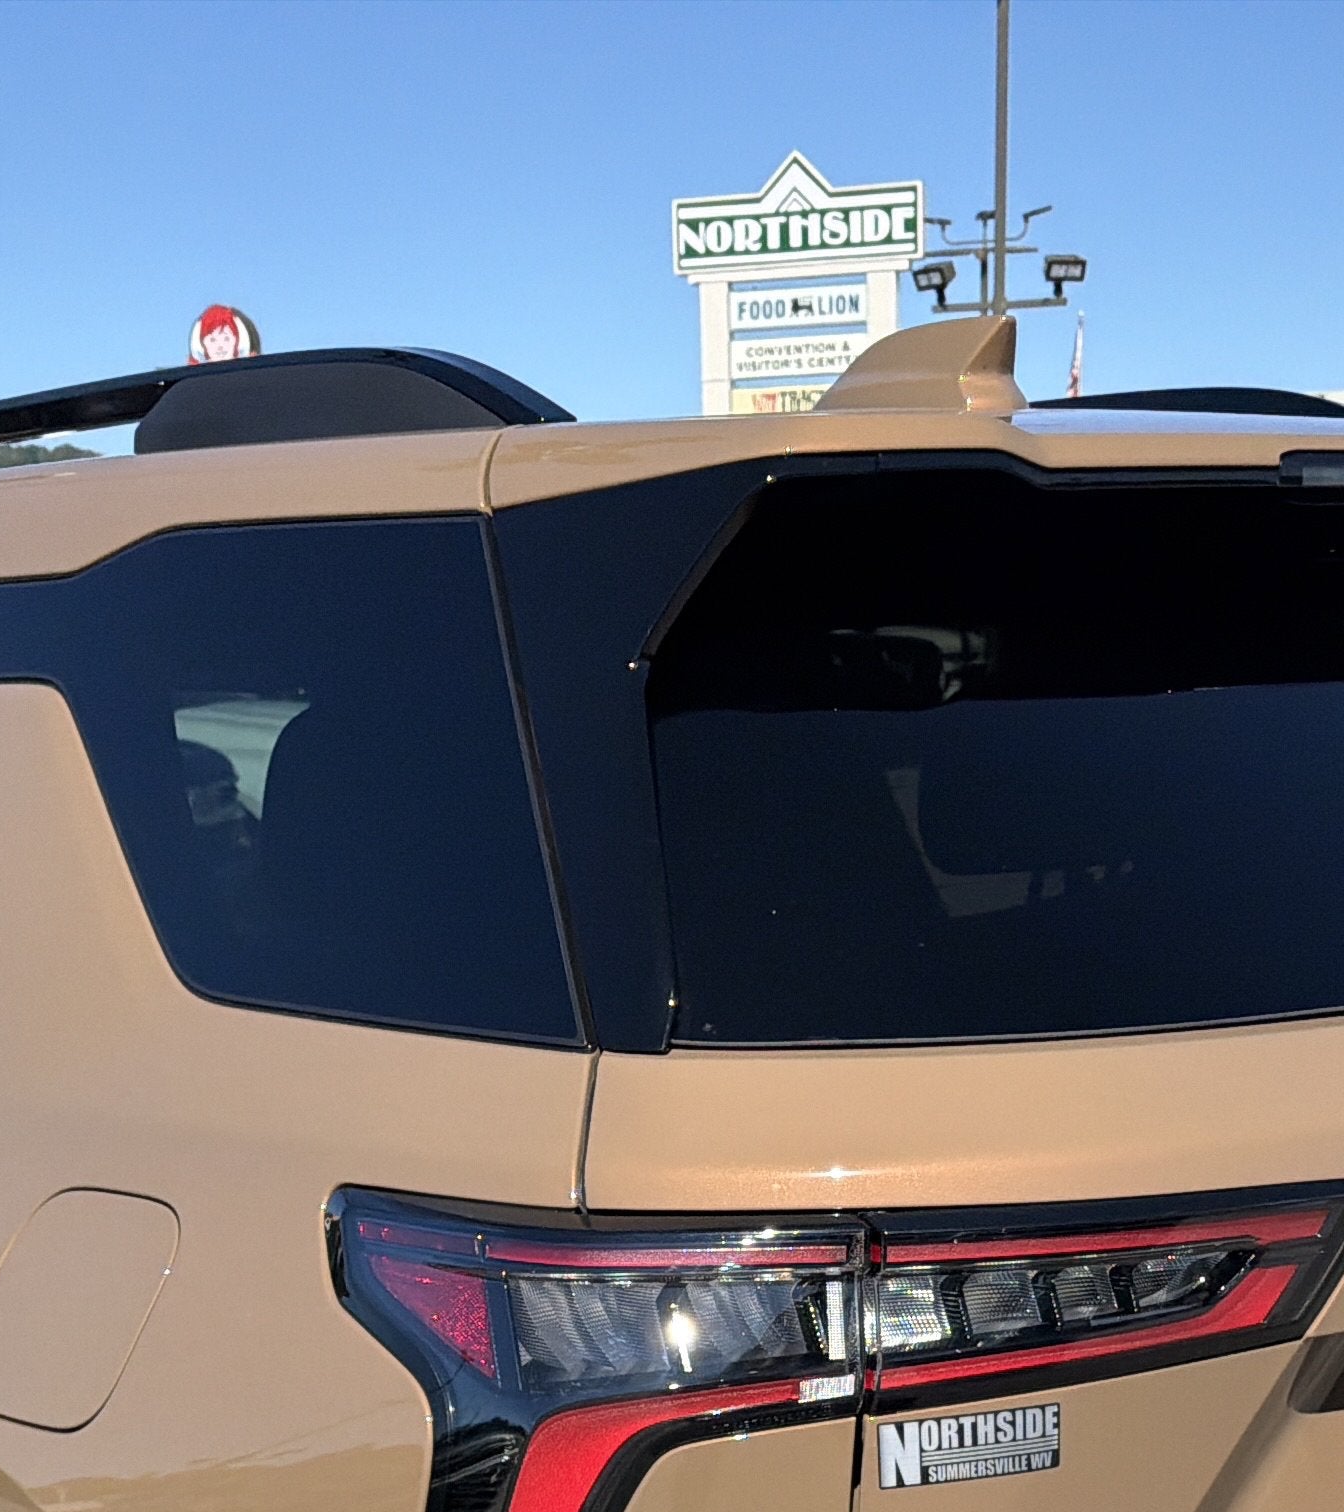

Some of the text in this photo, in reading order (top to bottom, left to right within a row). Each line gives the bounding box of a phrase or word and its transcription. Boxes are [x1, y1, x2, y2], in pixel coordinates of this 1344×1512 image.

[679, 206, 915, 255] NORTHSIDE
[738, 294, 859, 321] FOOD LION
[736, 355, 856, 372] VISITOR'S CENTE
[745, 343, 836, 357] CONVENTION
[879, 1405, 1058, 1488] NORTHSIDE
[928, 1451, 1053, 1483] SUMMERSVILLE WV
